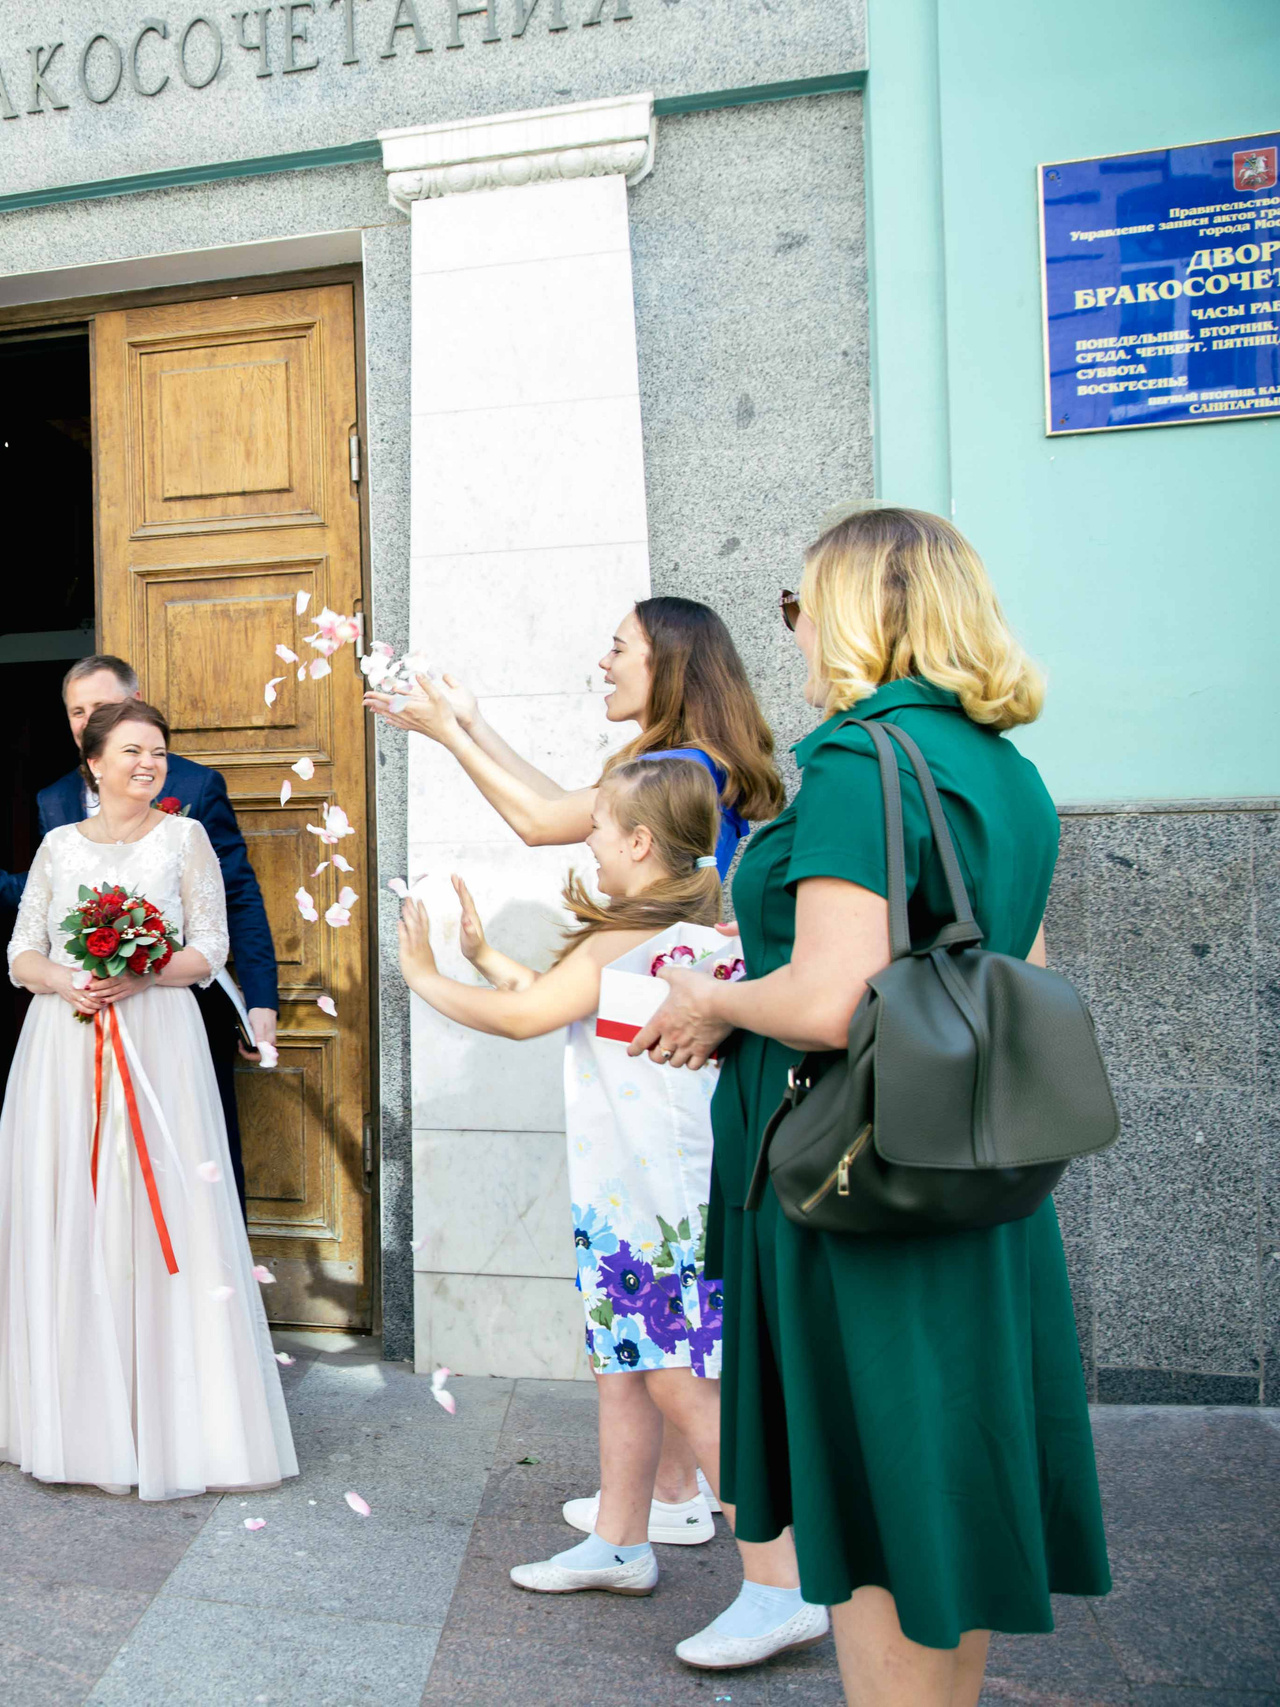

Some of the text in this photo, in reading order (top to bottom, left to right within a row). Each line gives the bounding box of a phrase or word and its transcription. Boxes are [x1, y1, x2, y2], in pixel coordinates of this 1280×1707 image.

[1169, 197, 1280, 219] Правительство
[1070, 224, 1155, 241] Управление
[1158, 217, 1209, 230] записи
[1213, 211, 1256, 223] актов
[1199, 223, 1251, 237] города
[1185, 241, 1280, 275] ДВОР
[1191, 304, 1245, 320] ЧАСЫ
[1076, 320, 1279, 351] ПОНЕДЕЛЬНИК, ВТОРНИК,
[1076, 333, 1280, 363] СРЕДА, ЧЕТВЕРГ, ПЯТНИЦ
[1076, 364, 1147, 379] СУББОТА
[1077, 376, 1188, 396] ВОСКРЕСЕНЬЕ
[1200, 388, 1256, 401] ВТОРНИК
